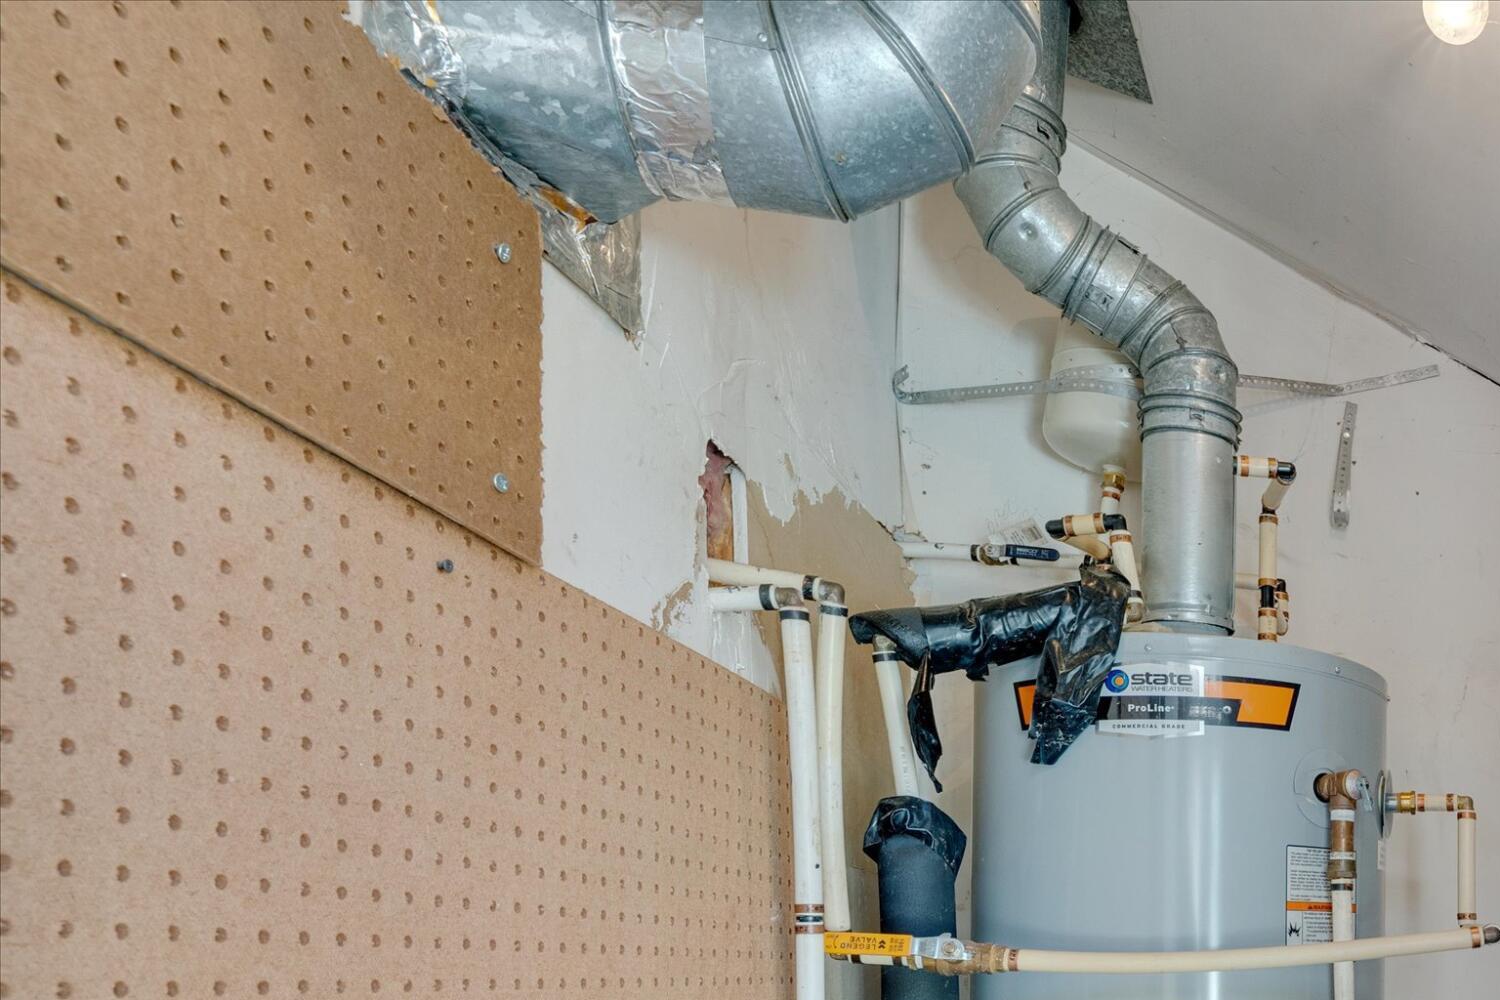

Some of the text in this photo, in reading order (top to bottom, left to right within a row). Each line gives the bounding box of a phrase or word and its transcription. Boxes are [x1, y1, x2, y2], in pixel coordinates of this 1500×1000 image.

[1131, 672, 1193, 686] state
[1127, 703, 1171, 713] ProLine
[850, 935, 877, 943] VALVE
